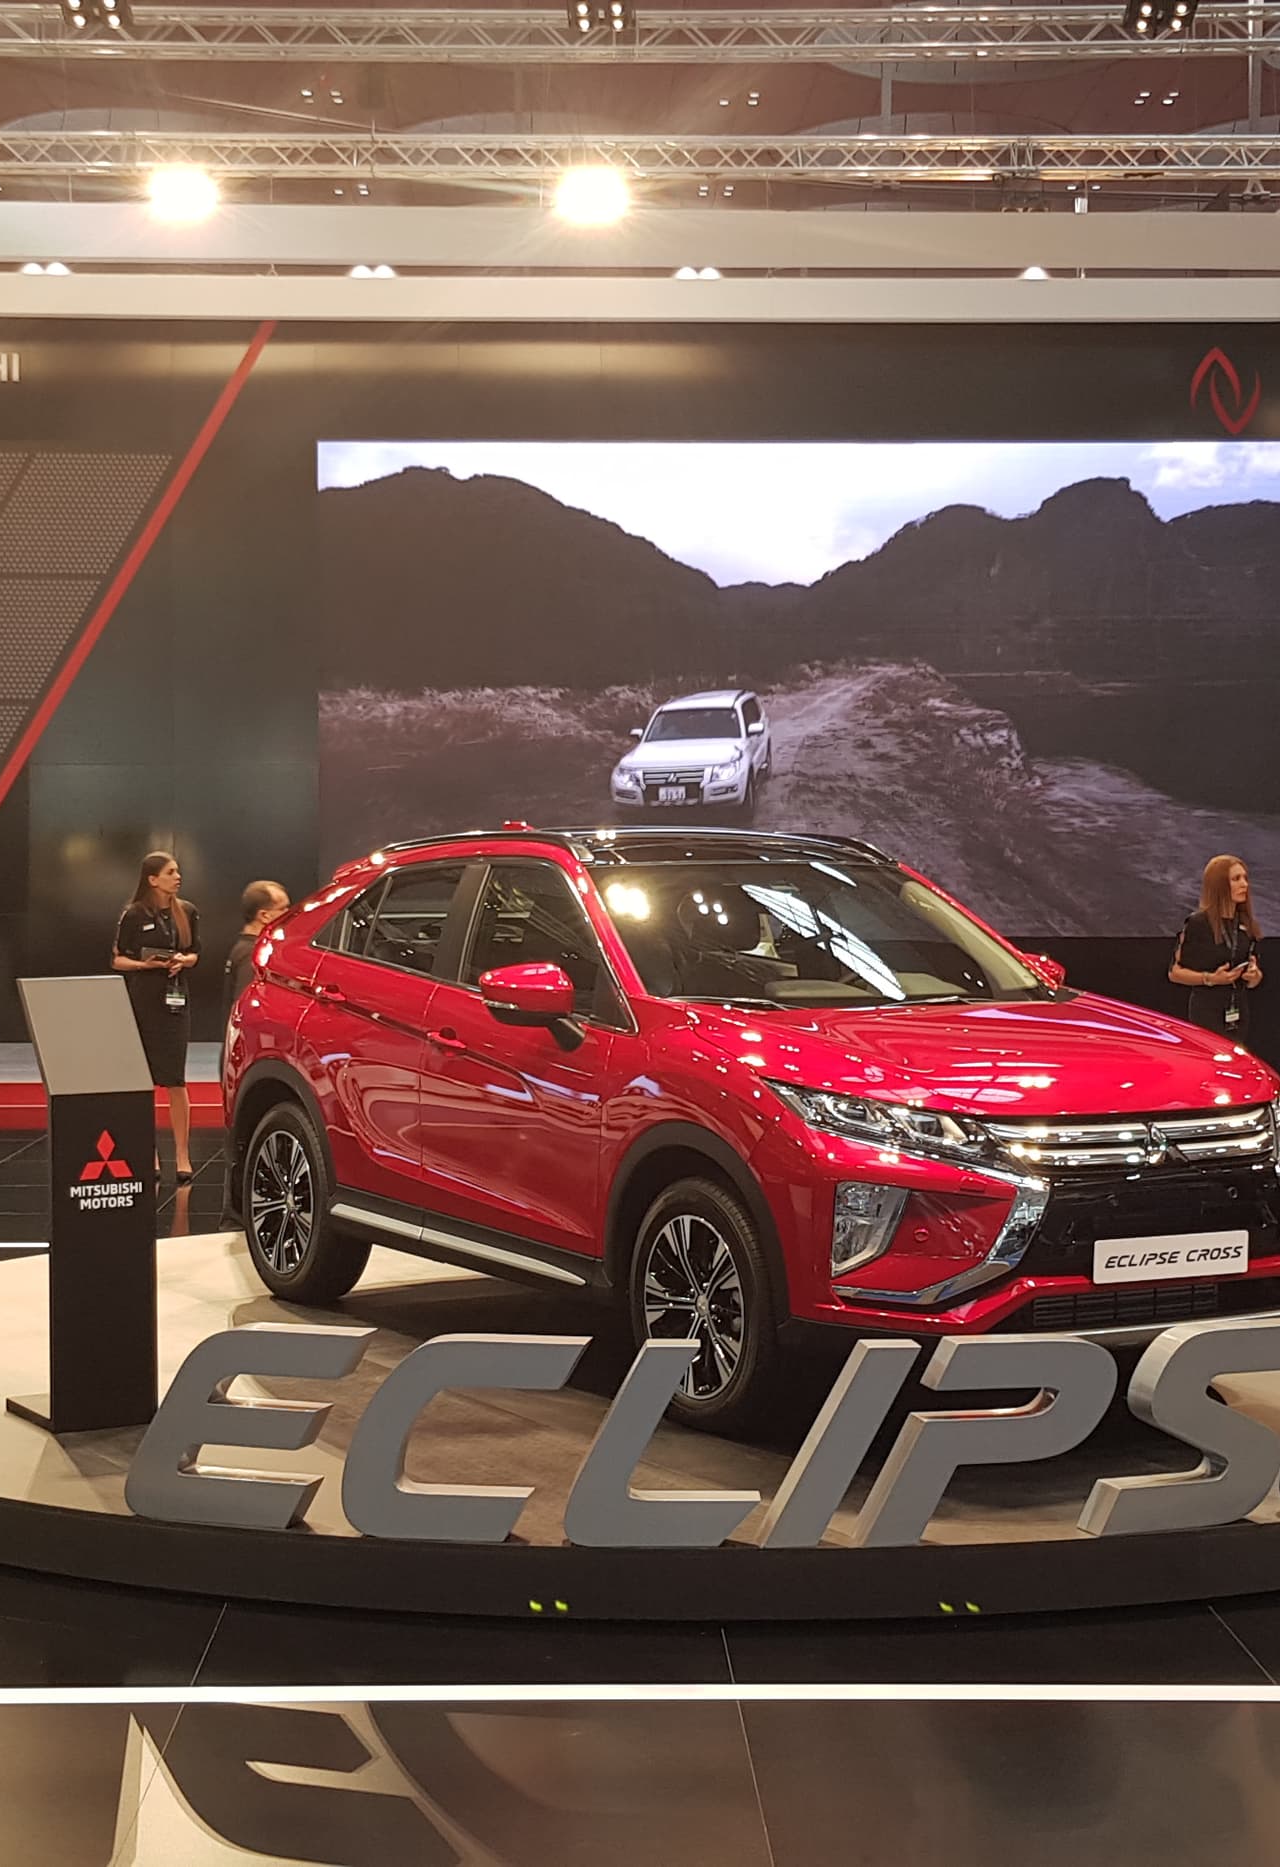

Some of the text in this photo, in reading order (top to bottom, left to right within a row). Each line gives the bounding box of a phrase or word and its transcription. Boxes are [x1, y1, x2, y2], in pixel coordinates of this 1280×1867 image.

[70, 1182, 143, 1198] MITSUBISHI
[80, 1195, 134, 1210] MOTORS
[1104, 1245, 1243, 1269] ECLIPSE CROSS
